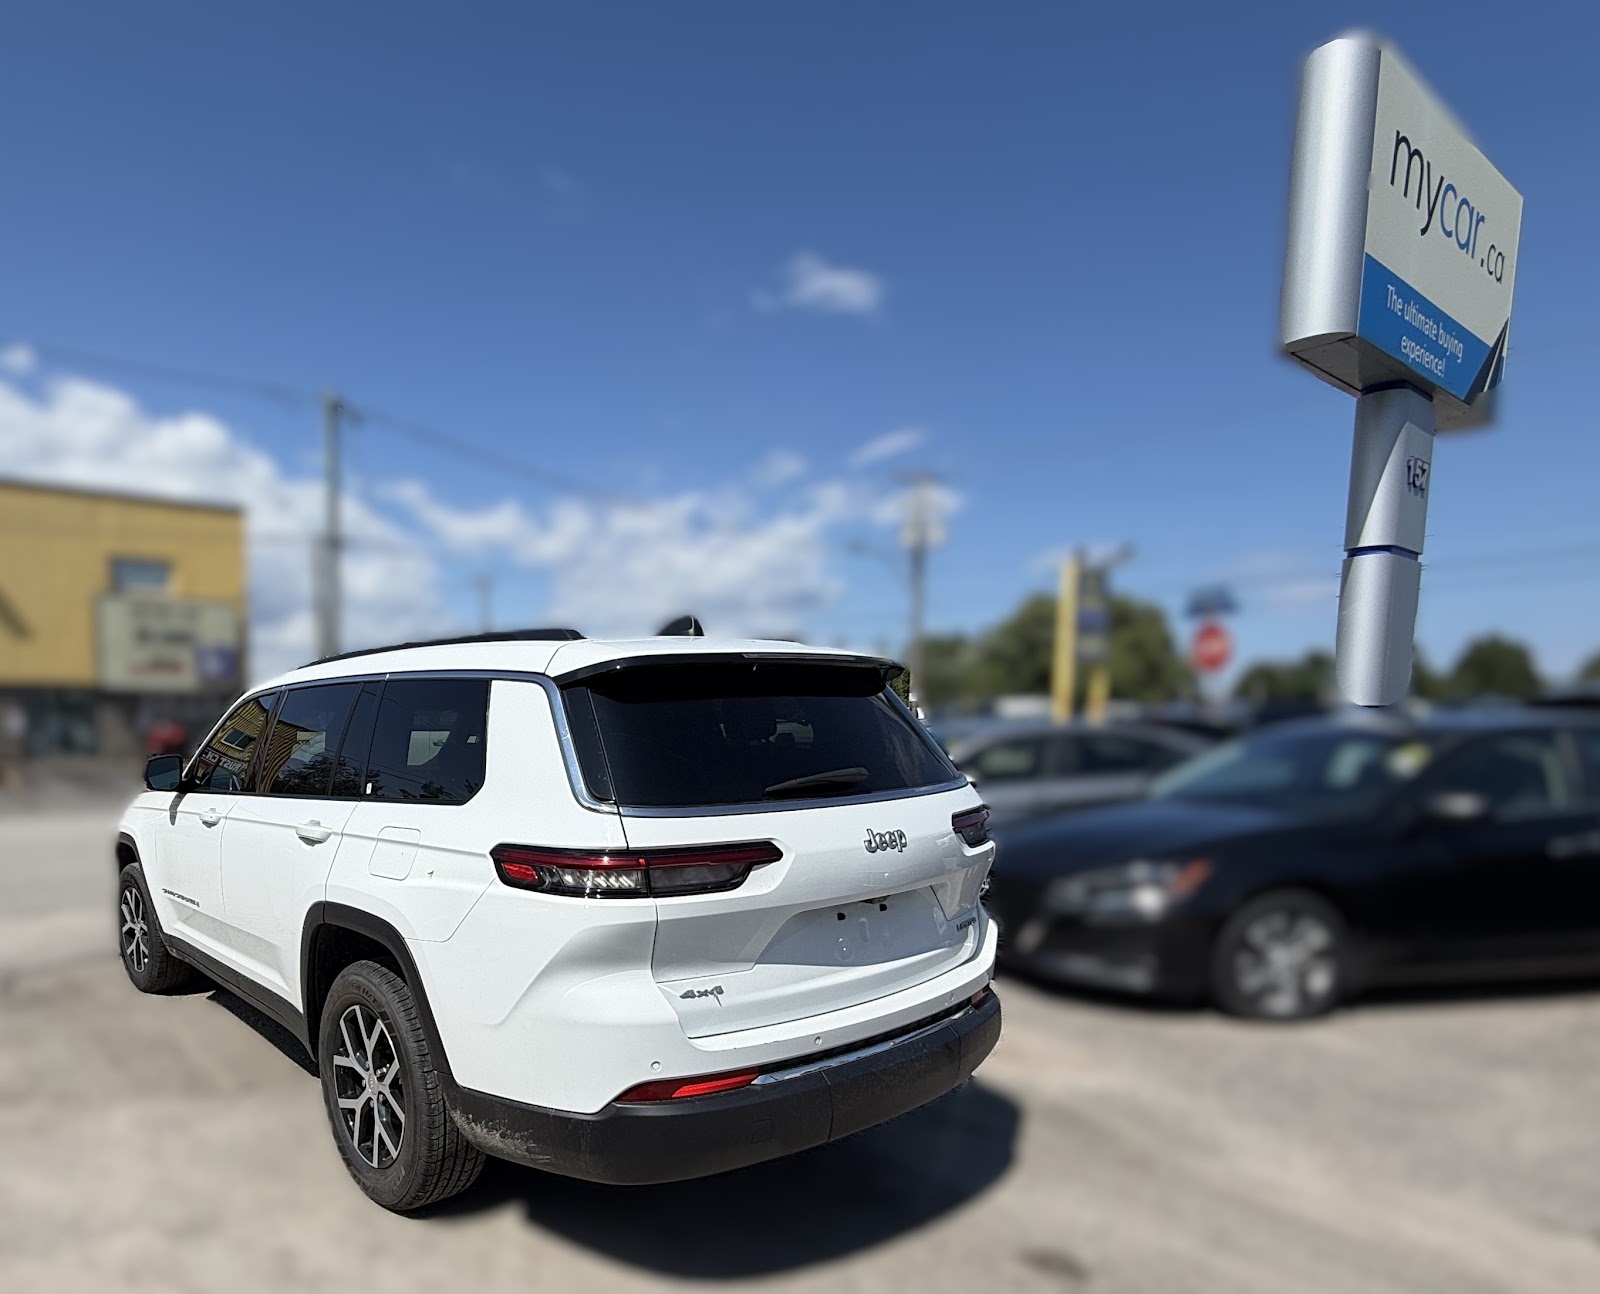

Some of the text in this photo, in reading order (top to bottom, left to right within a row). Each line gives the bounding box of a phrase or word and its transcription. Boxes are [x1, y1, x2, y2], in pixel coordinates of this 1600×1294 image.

[1390, 129, 1505, 285] mycar.ca
[1387, 284, 1464, 363] The ultimate buying
[1401, 335, 1446, 378] experience!
[864, 828, 908, 853] Jeep
